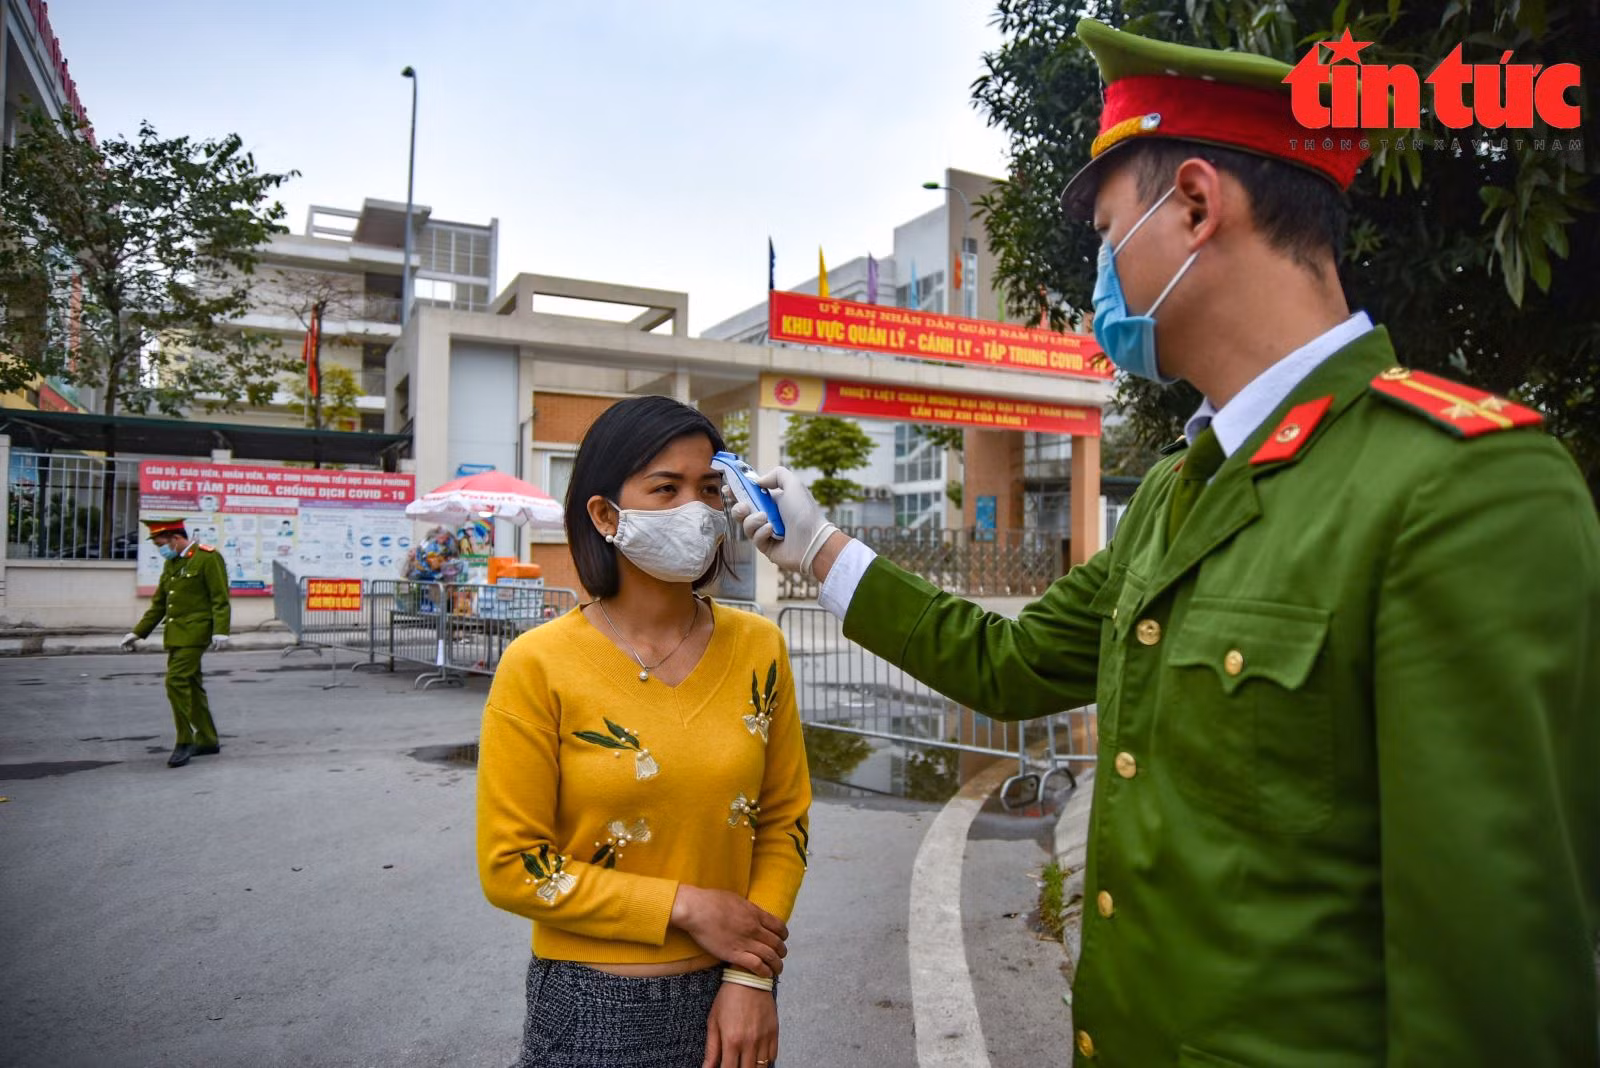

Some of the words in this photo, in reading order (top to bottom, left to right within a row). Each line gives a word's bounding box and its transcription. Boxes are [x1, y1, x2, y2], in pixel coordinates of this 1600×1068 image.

[844, 306, 877, 318] BAN
[880, 310, 922, 325] NHÂN
[925, 317, 955, 330] DÂN
[999, 328, 1030, 341] NAM
[782, 314, 813, 336] KHU
[815, 319, 846, 342] VỰC
[848, 320, 887, 346] QUẢN
[889, 327, 906, 348] LÝ
[956, 338, 973, 357] LY
[982, 340, 1007, 363] TẬP
[1008, 346, 1048, 367] TRUNG
[1050, 351, 1084, 370] COVID
[911, 405, 932, 417] LẦN
[152, 478, 193, 491] QUYẾT
[196, 480, 224, 493] TÂM
[226, 482, 273, 496] PHÒNG,
[275, 483, 316, 497] CHỐNG
[318, 487, 346, 500] DỊCH
[348, 489, 382, 500] COVID
